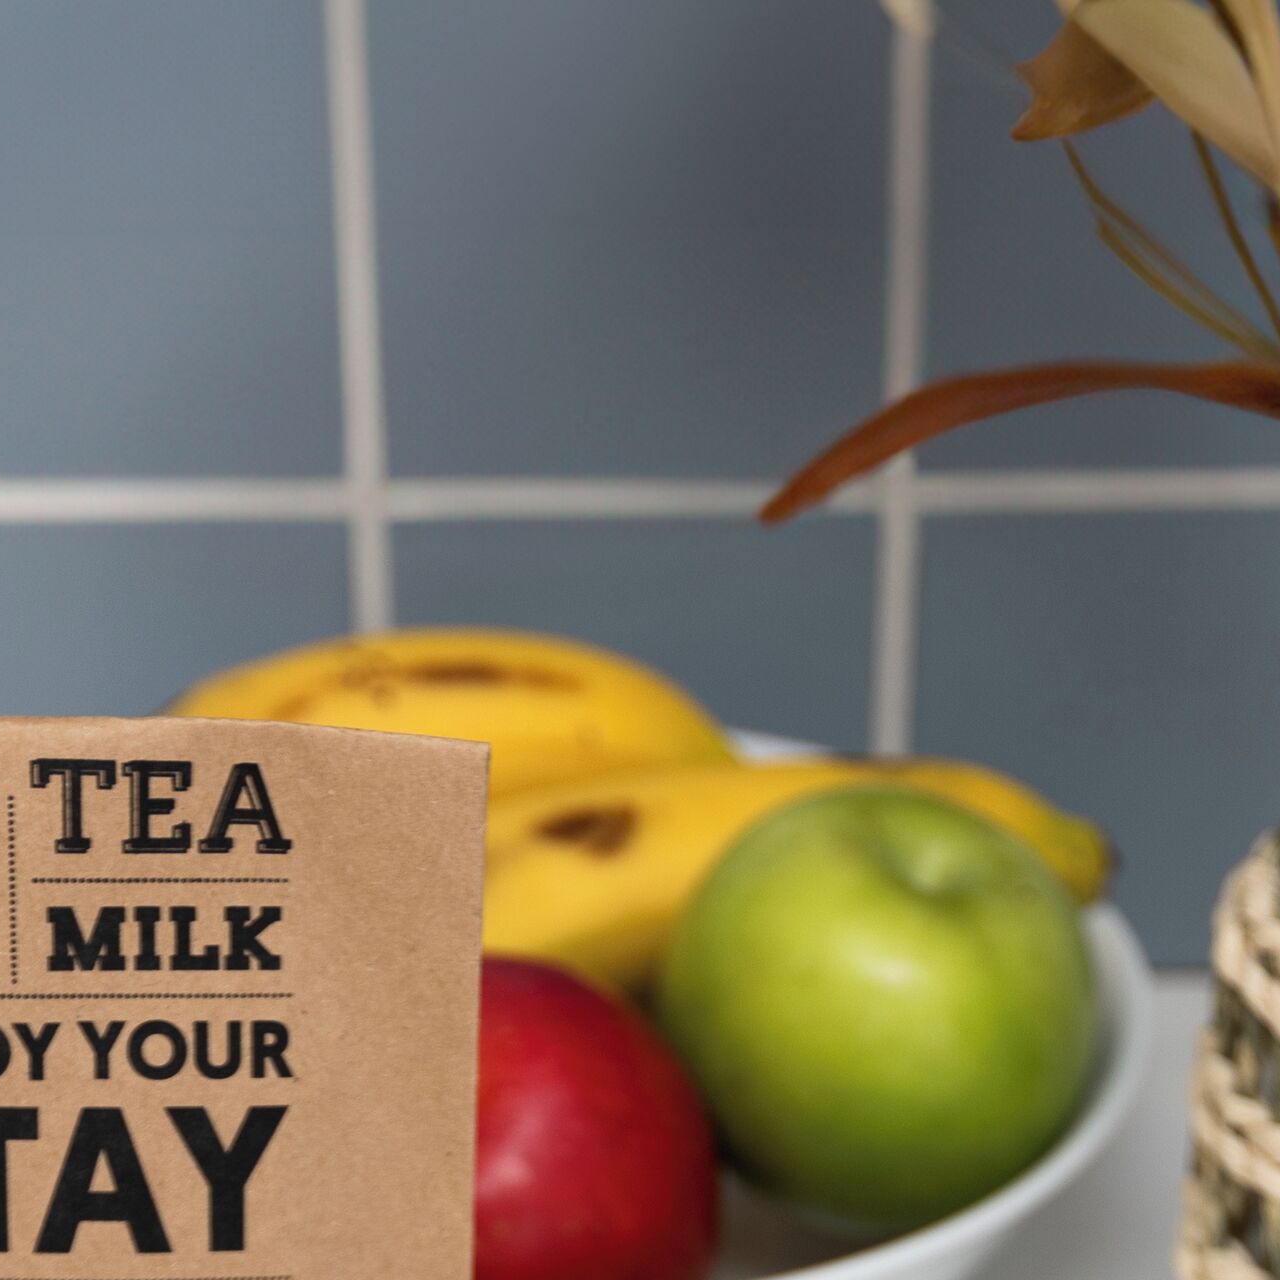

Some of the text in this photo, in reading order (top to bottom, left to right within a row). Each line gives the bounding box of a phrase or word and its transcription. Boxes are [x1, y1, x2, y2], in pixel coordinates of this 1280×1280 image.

[29, 758, 292, 855] TEA
[46, 905, 282, 972] MILK
[77, 1020, 294, 1081] YOUR
